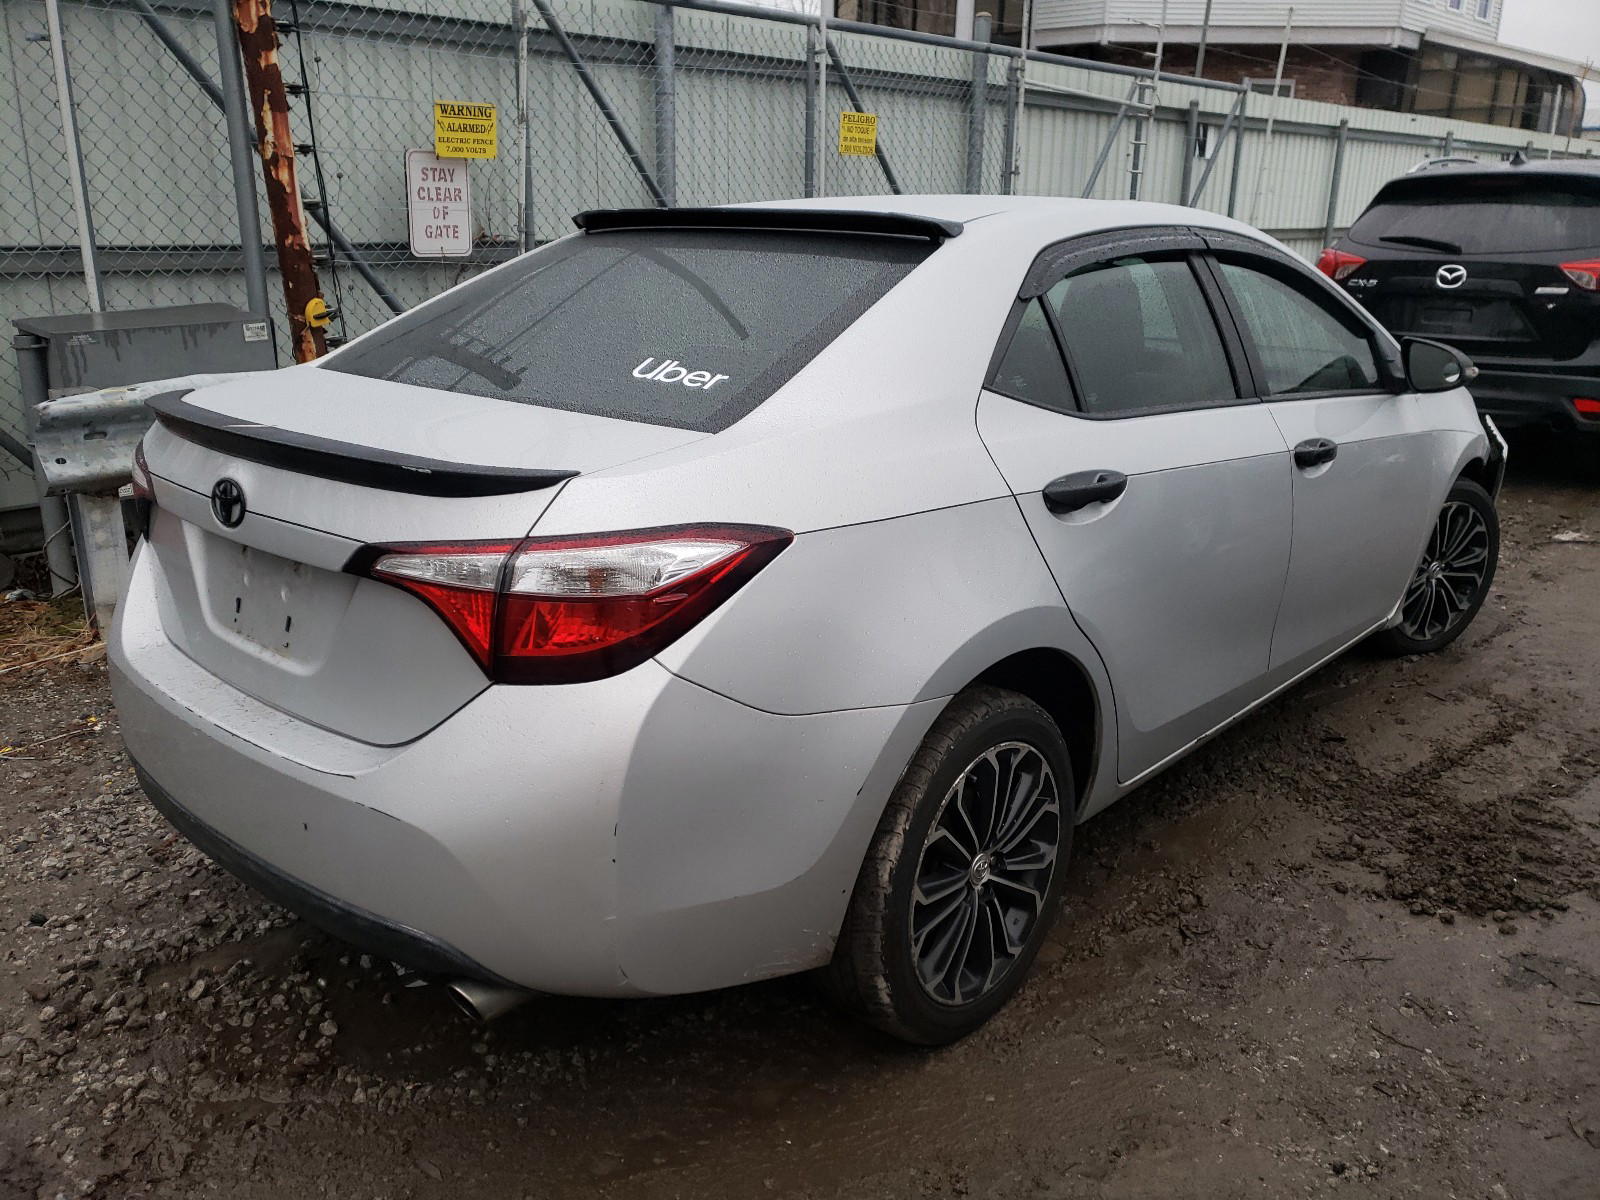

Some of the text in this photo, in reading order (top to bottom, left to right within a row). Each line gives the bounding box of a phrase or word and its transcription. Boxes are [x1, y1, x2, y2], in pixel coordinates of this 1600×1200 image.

[440, 104, 492, 118] WARNING
[843, 114, 876, 125] PELIGRO
[447, 122, 486, 133] ALARMED
[421, 167, 455, 182] STAY
[417, 186, 462, 201] CLEAR
[433, 205, 449, 220] OF
[425, 224, 459, 239] GATE
[632, 357, 730, 390] Uber
